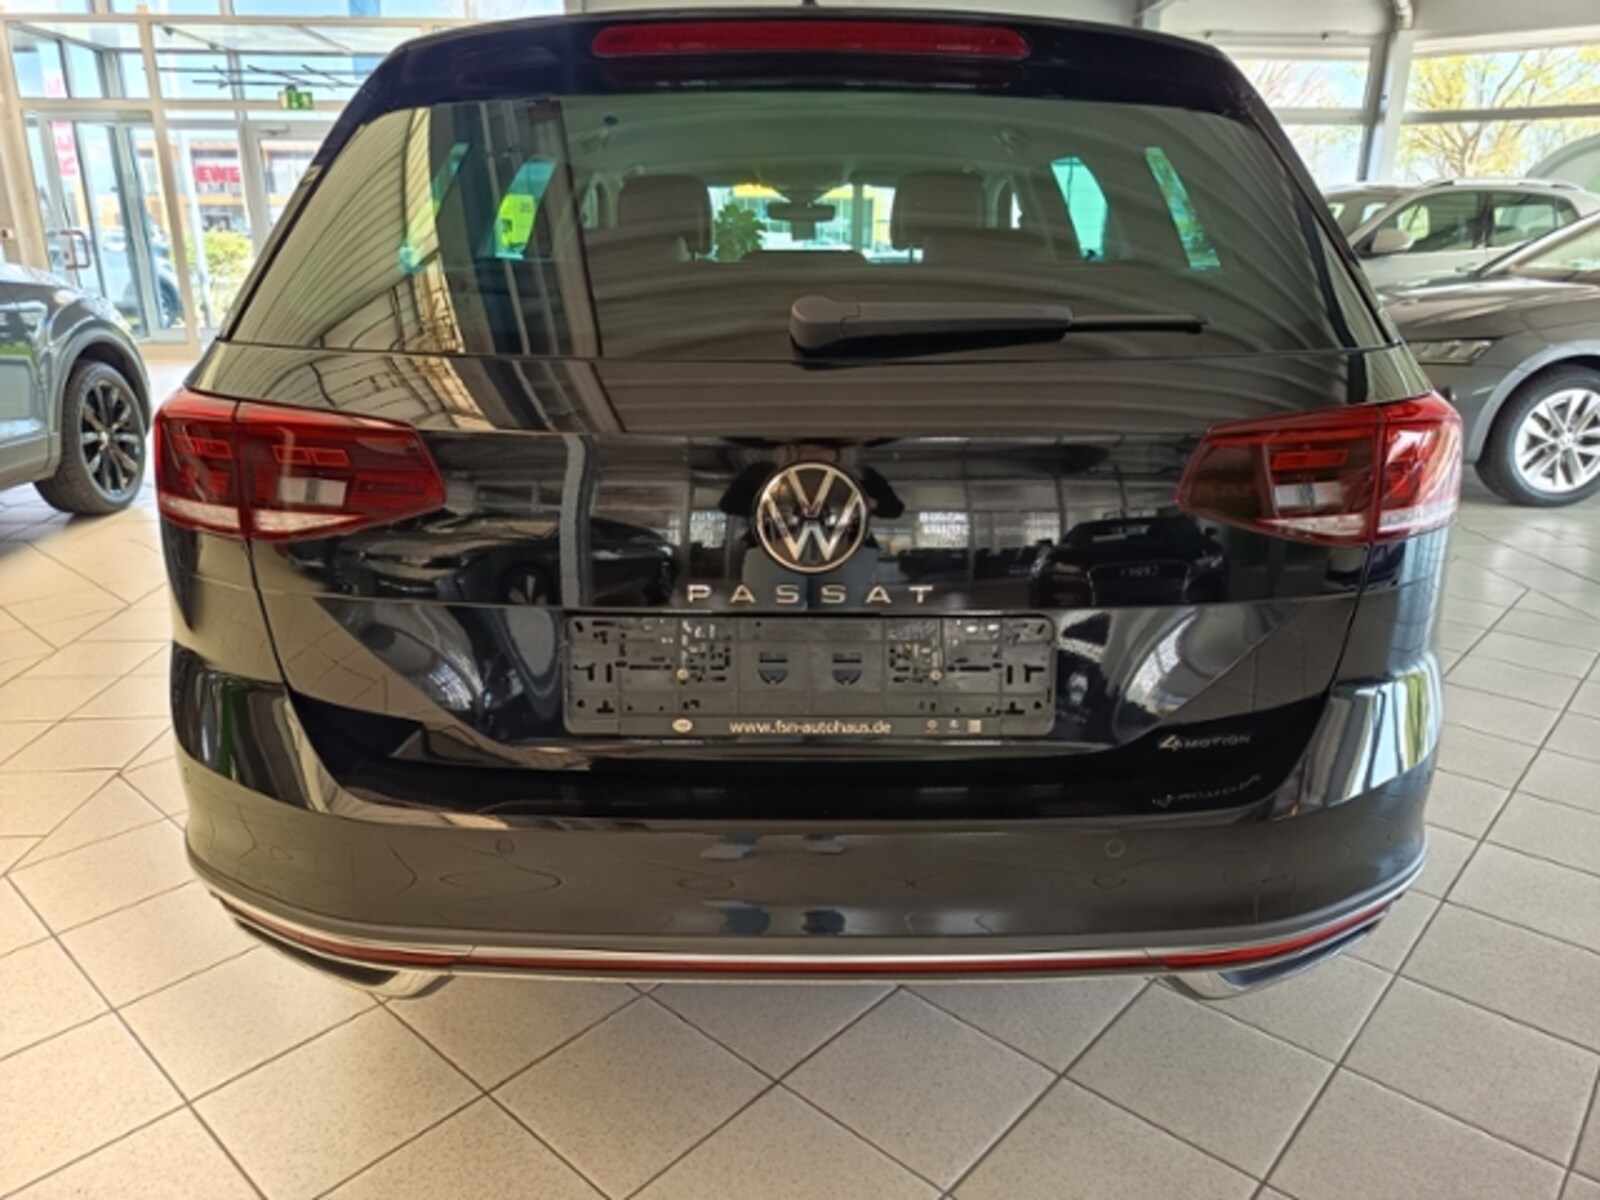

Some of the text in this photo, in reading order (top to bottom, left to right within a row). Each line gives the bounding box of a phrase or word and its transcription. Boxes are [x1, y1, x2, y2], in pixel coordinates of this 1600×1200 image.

[48, 77, 77, 176] REE
[193, 164, 241, 184] EWE
[686, 584, 933, 604] PASSAT
[1159, 734, 1251, 752] 4MOTION
